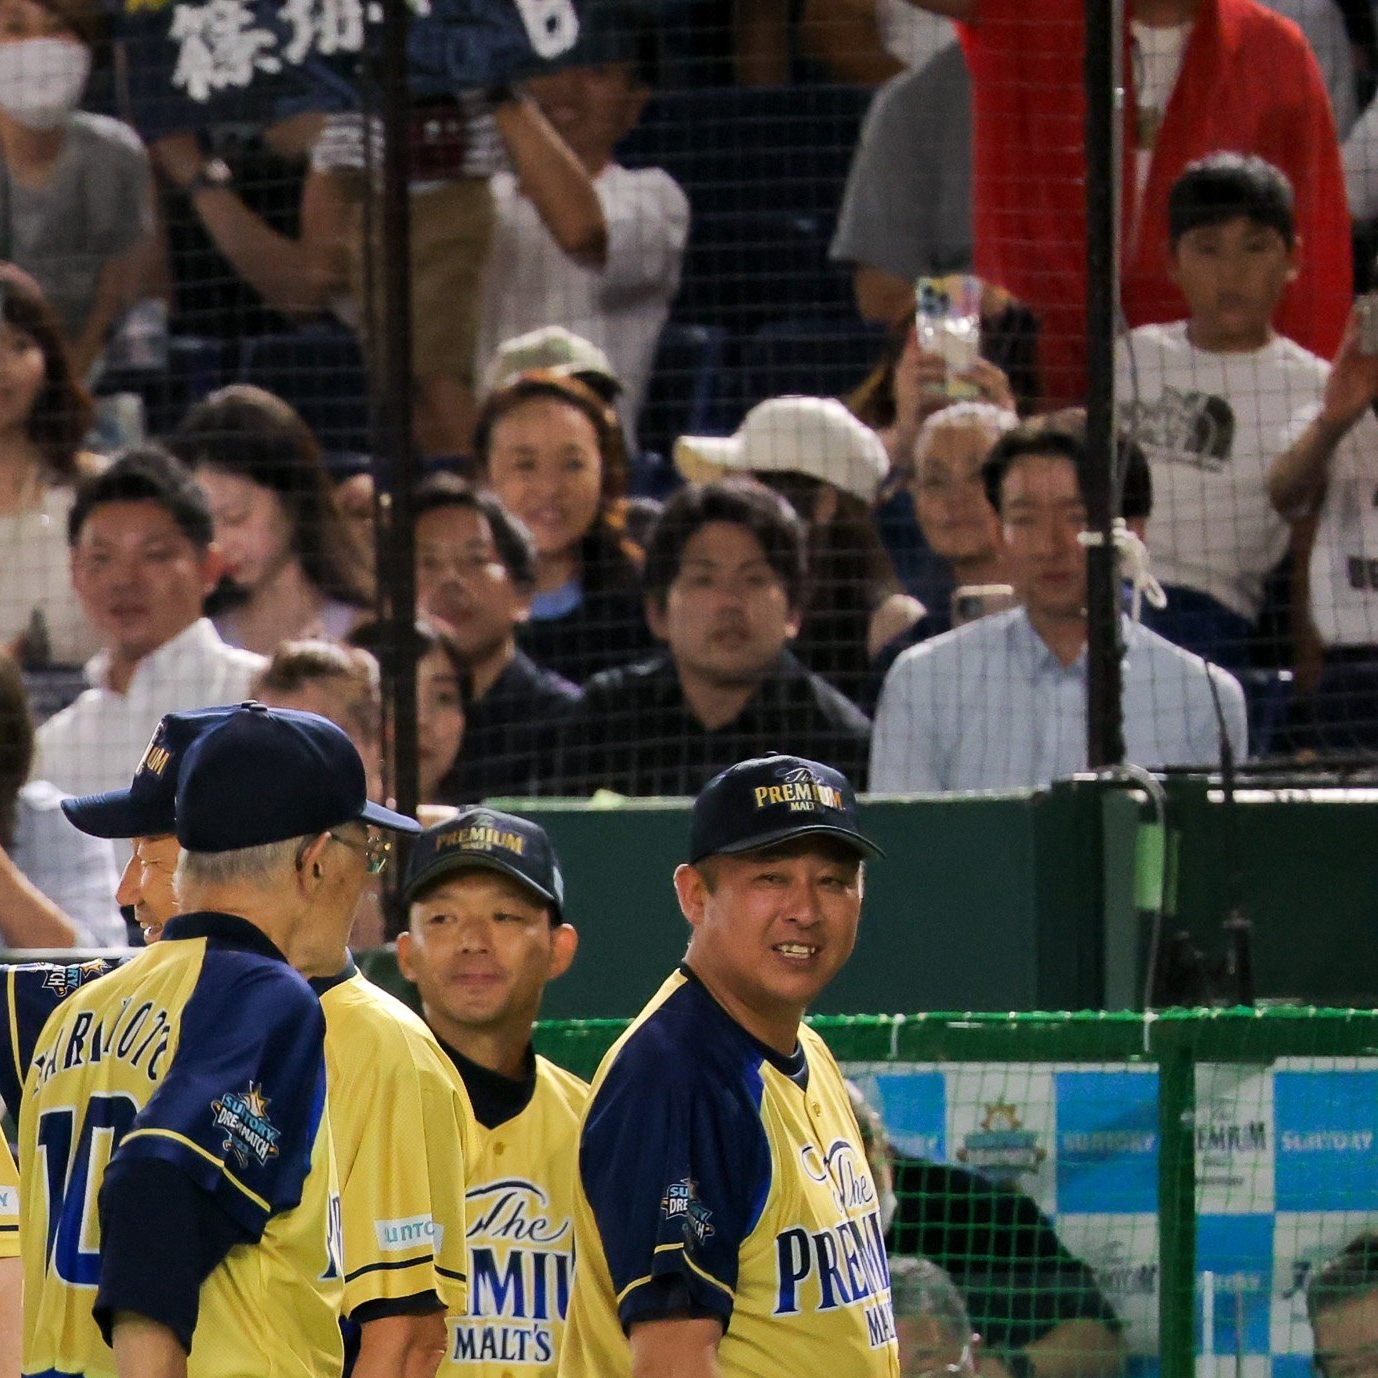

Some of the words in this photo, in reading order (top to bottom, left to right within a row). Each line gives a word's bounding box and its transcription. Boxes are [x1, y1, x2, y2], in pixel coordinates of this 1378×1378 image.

[754, 782, 846, 812] PREMIUM
[36, 1091, 140, 1288] 10
[466, 1178, 573, 1242] The
[773, 1211, 891, 1317] PREM
[452, 1322, 554, 1364] MALT'S
